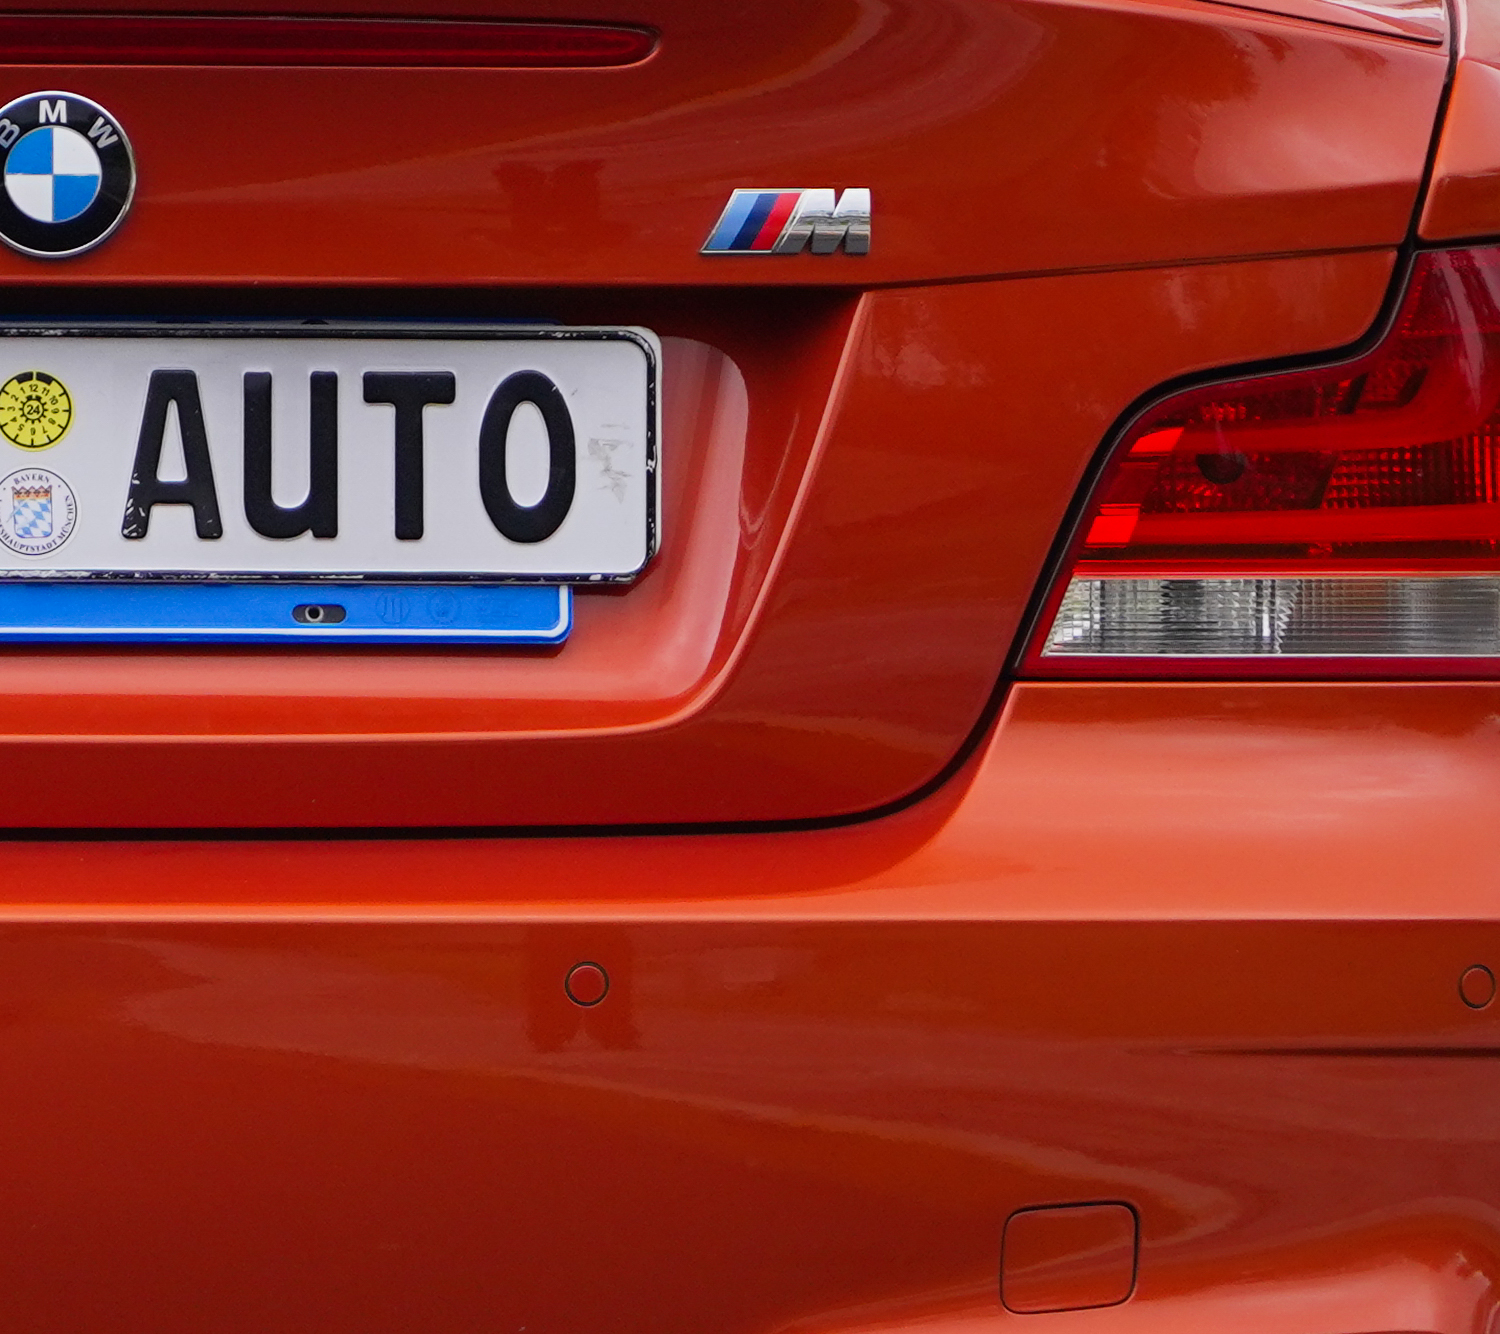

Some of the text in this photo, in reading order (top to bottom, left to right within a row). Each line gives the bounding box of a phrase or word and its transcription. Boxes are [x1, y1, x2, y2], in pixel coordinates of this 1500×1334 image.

[771, 188, 872, 254] M
[29, 384, 39, 392] 12
[41, 387, 50, 396] 11
[26, 404, 40, 415] 24
[119, 369, 575, 543] AUTO
[13, 473, 50, 485] BAYERN
